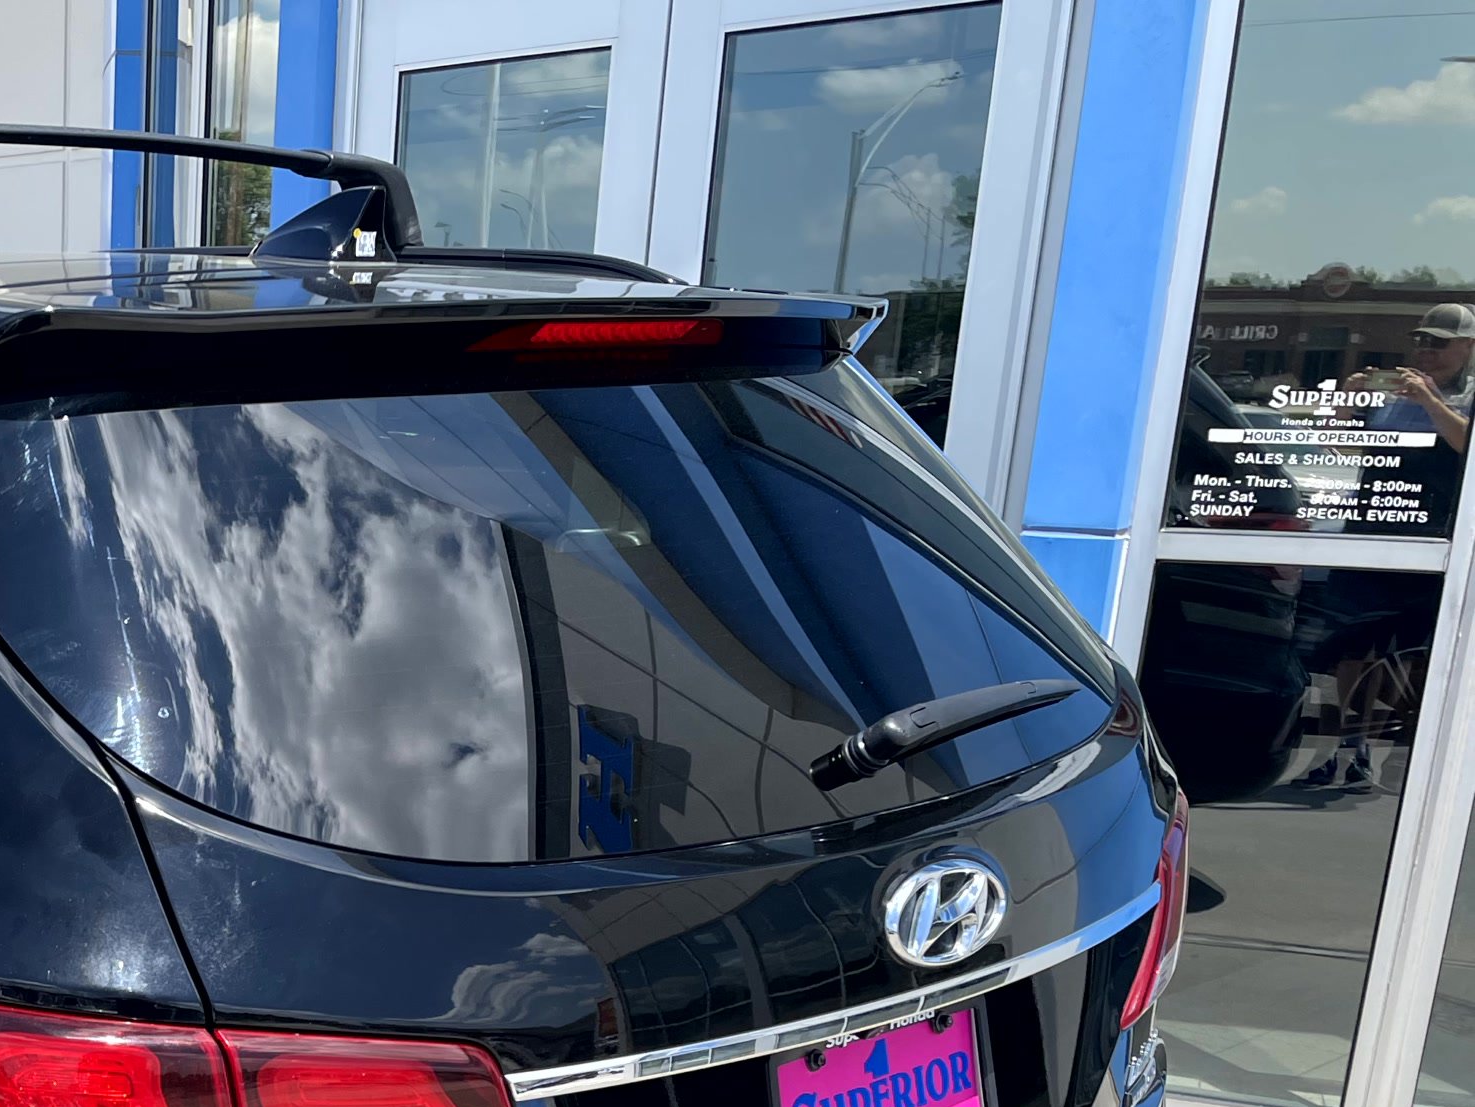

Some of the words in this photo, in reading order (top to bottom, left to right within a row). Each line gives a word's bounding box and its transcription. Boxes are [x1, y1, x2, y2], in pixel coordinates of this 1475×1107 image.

[1268, 385, 1386, 409] SUPERIOR
[1281, 417, 1314, 427] Honda
[1317, 417, 1327, 427] of
[1329, 418, 1365, 428] Omaha
[1243, 430, 1293, 442] HOURS
[1296, 431, 1314, 443] OF
[1318, 432, 1399, 444] OPERATION
[1234, 452, 1284, 465] SALES
[1288, 454, 1298, 466] &
[1303, 453, 1401, 468] SHOWROOM
[1193, 474, 1231, 487] Mon.
[1245, 475, 1293, 489] Thurs.
[1191, 489, 1215, 502] Fri.
[1228, 490, 1258, 503] Sat.
[1189, 504, 1254, 518] SUNDAY
[1296, 507, 1362, 521] SPECIAL
[1366, 511, 1429, 523] EVENTS
